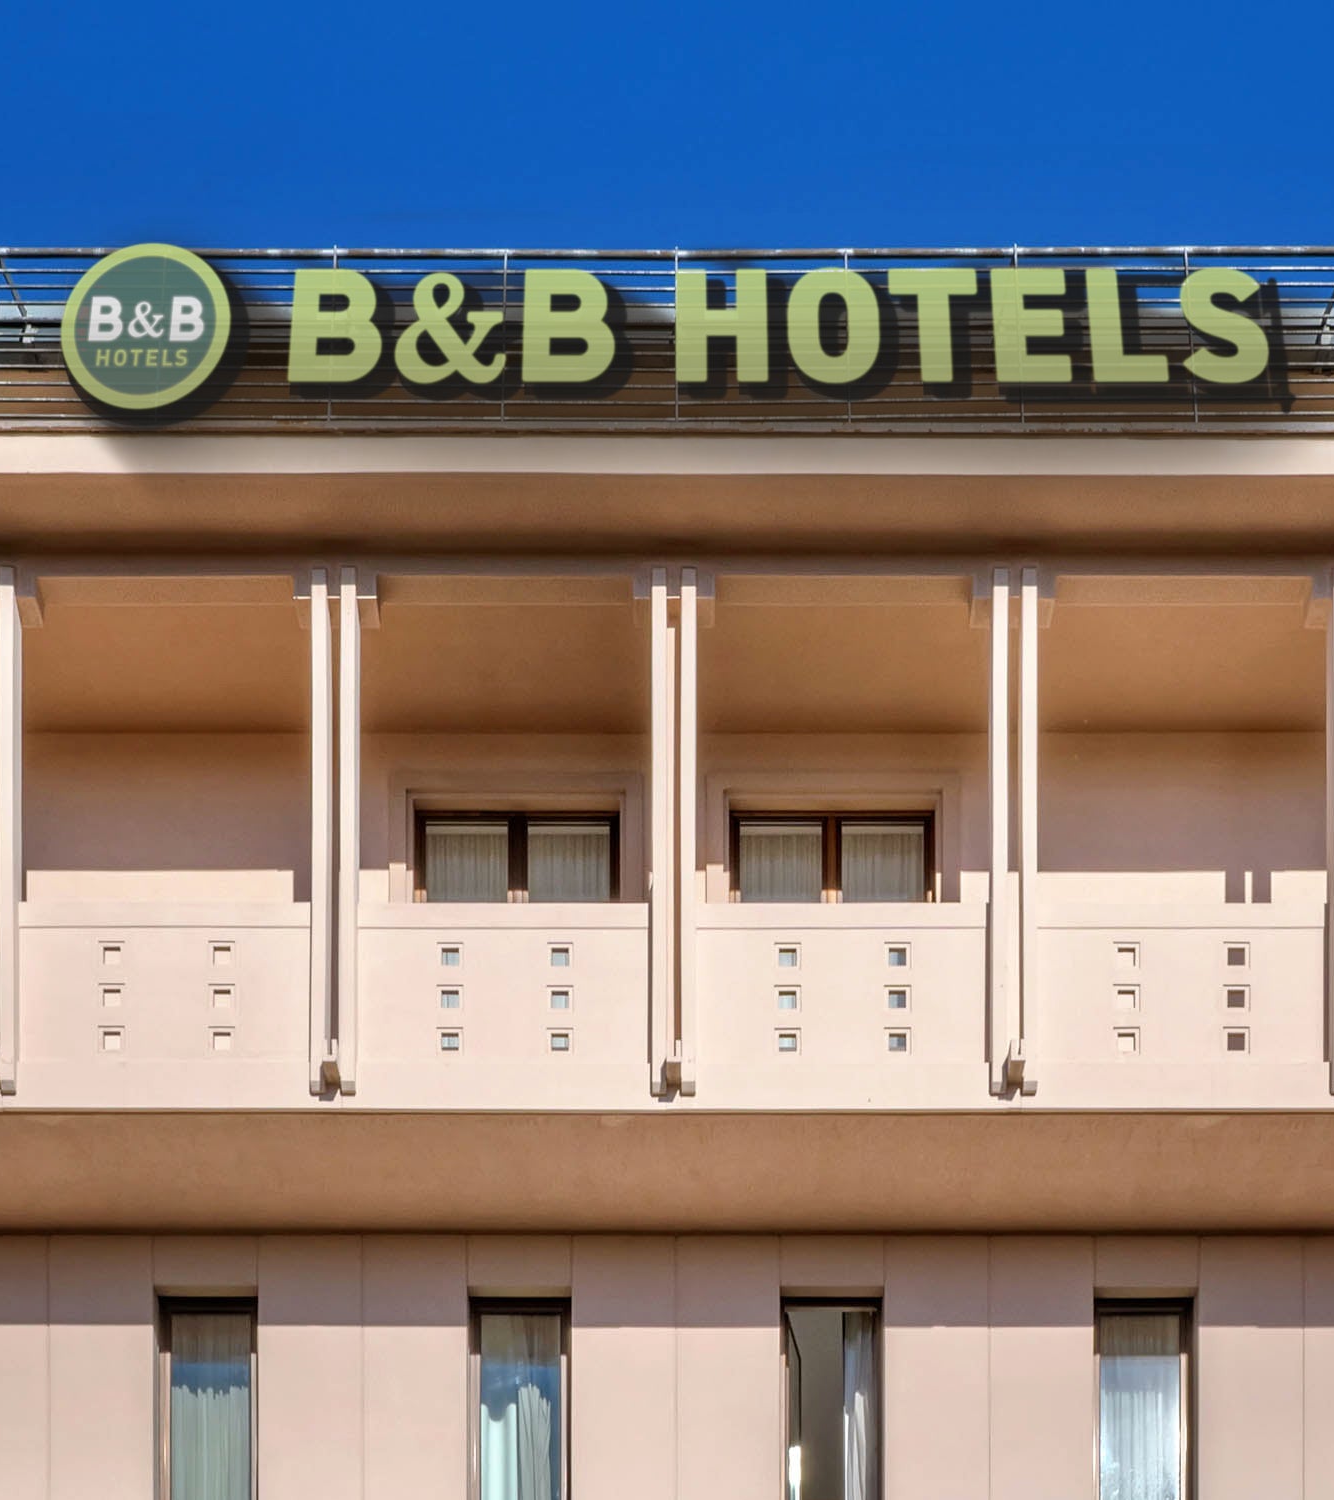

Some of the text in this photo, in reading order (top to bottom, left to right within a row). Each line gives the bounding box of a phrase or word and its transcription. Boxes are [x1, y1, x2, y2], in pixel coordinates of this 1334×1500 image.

[87, 295, 205, 342] B&B
[287, 267, 1270, 384] B&B HOTELS
[95, 349, 188, 367] HOTELS
